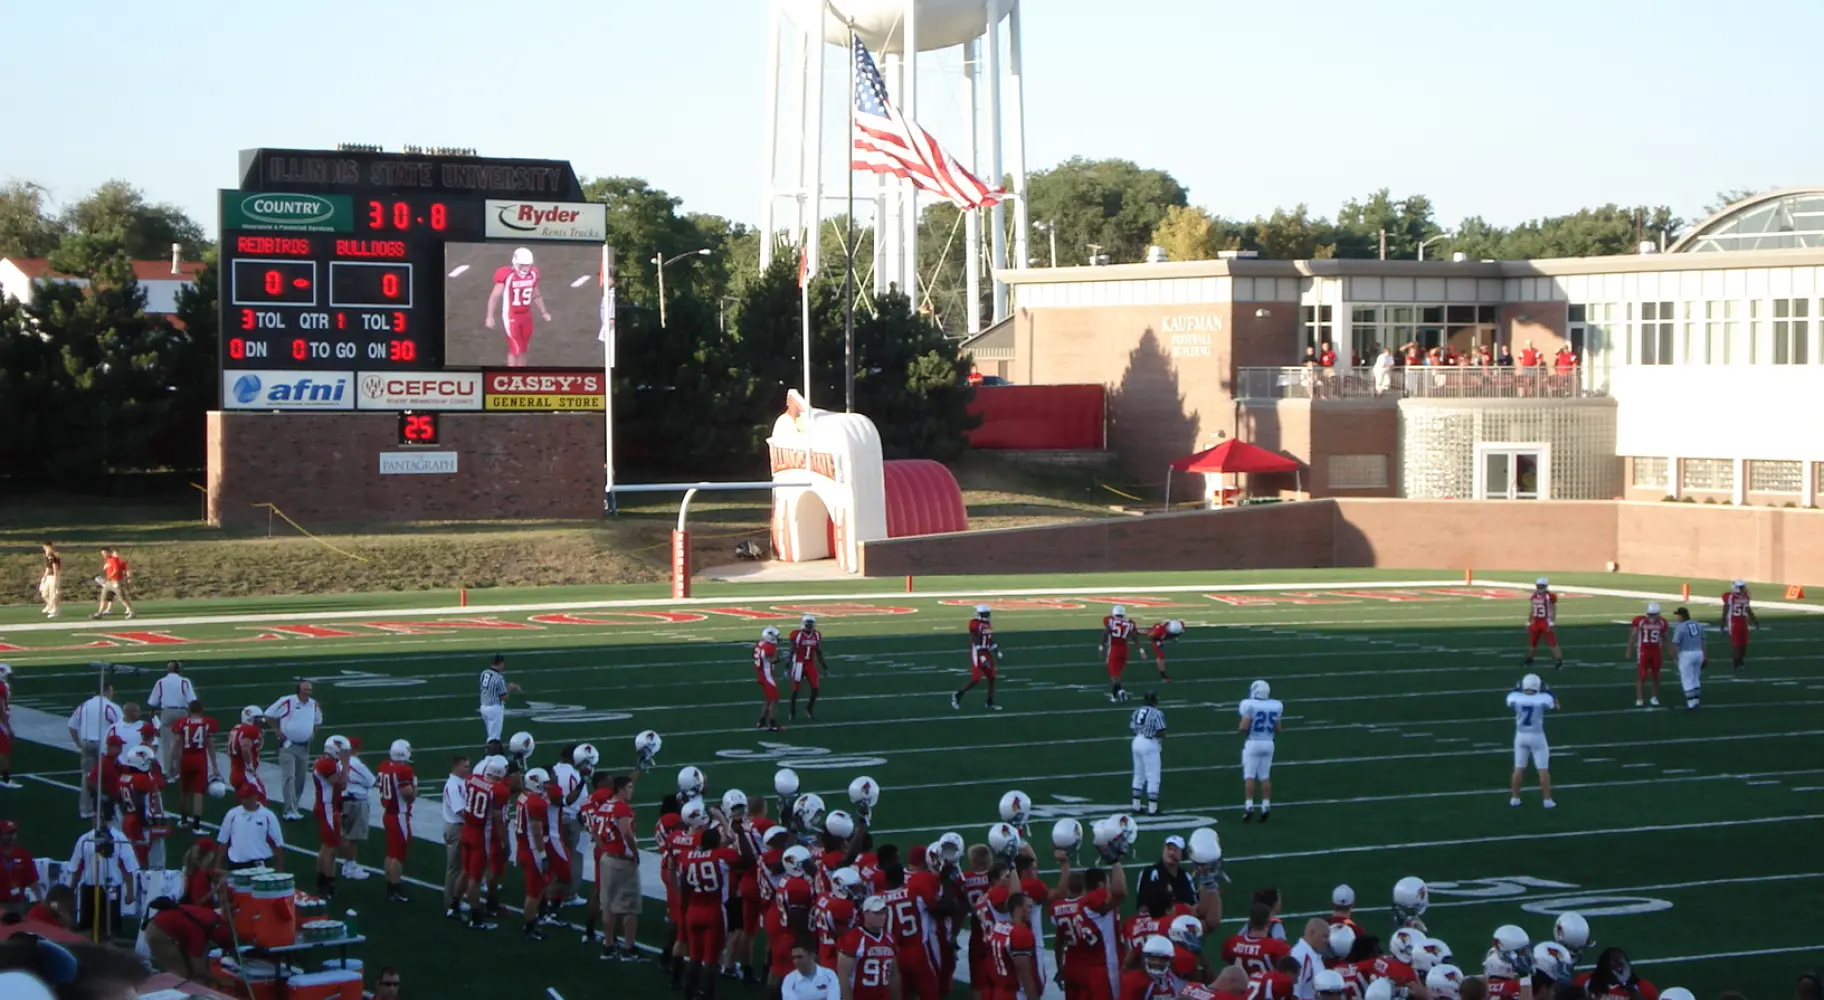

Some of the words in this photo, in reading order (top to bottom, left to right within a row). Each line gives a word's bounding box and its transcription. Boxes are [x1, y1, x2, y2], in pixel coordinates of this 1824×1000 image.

[270, 156, 359, 183] ILLINOIS
[370, 160, 433, 187] STATE
[441, 163, 562, 192] UNIVERSITY
[254, 199, 320, 214] COUNTRY
[518, 204, 579, 225] Ryder
[237, 236, 309, 254] REDBIRDS
[336, 239, 405, 256] BULLDOGS
[265, 270, 282, 295] 0
[382, 273, 398, 297] 0
[256, 312, 285, 329] TOL
[300, 313, 329, 329] QTR
[336, 312, 346, 329] 1
[362, 314, 390, 330] TOL
[392, 312, 407, 332] 3
[1162, 316, 1222, 331] KAUFMAN
[246, 341, 267, 357] DN
[310, 342, 330, 358] TO
[336, 342, 356, 358] GO
[368, 343, 386, 359] ON
[389, 340, 416, 361] 30
[267, 379, 346, 401] afni
[386, 380, 474, 396] CEFCU
[493, 376, 598, 392] CASEY'S
[493, 397, 552, 407] GENERAL
[559, 397, 599, 407] STORE
[404, 415, 434, 440] 25
[382, 459, 455, 472] PANTAGRAPH
[1112, 622, 1130, 639] 57
[1254, 711, 1278, 733] 25
[1522, 706, 1534, 726] 7
[183, 725, 205, 749] 14
[464, 786, 489, 819] 10
[686, 861, 719, 893] 49
